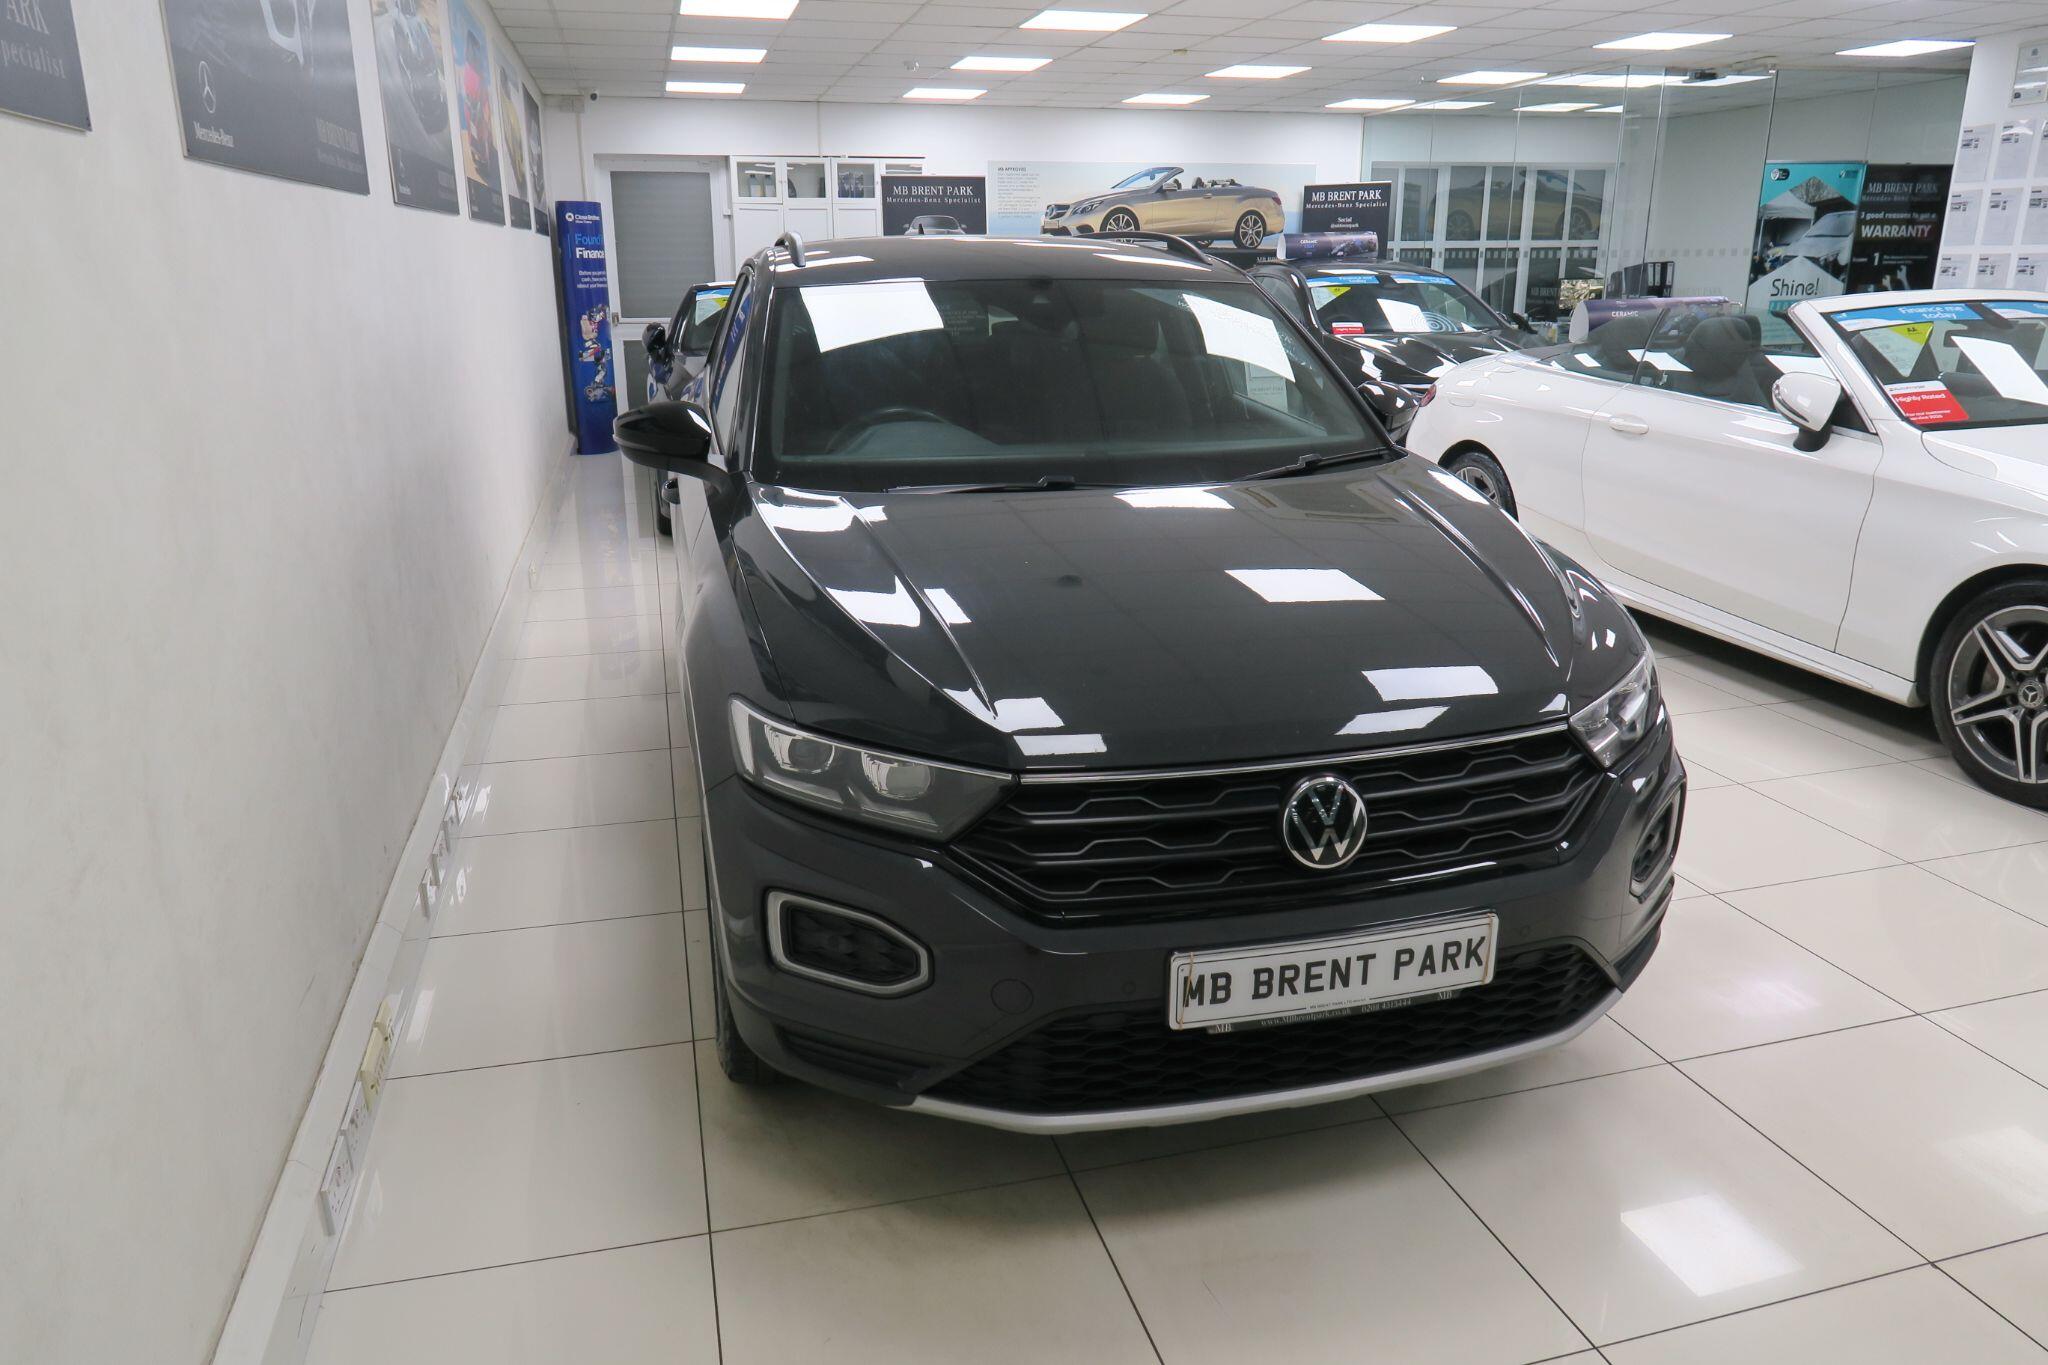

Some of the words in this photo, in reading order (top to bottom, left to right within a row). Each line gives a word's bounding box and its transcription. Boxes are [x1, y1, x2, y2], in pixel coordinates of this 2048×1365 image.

[893, 186, 908, 196] MB
[912, 186, 943, 196] BRENT
[947, 186, 973, 195] PARK
[1884, 182, 1914, 193] BRENT
[1312, 192, 1326, 202] MB
[1327, 191, 1356, 201] BRENT
[1358, 189, 1382, 200] PARK
[1355, 201, 1388, 209] Specialist
[1866, 211, 1885, 220] good
[1861, 225, 1931, 238] WARRANTY
[1873, 252, 1880, 266] 1
[1770, 277, 1820, 297] Shine!
[1611, 310, 1639, 318] CERAMIC
[1898, 306, 1945, 315] Finance
[1922, 311, 1957, 319] today
[1895, 394, 1921, 403] Highly
[1183, 972, 1232, 1008] MB
[1252, 954, 1376, 1000] BRENT
[1393, 936, 1486, 981] PARK
[1216, 1023, 1232, 1033] MB
